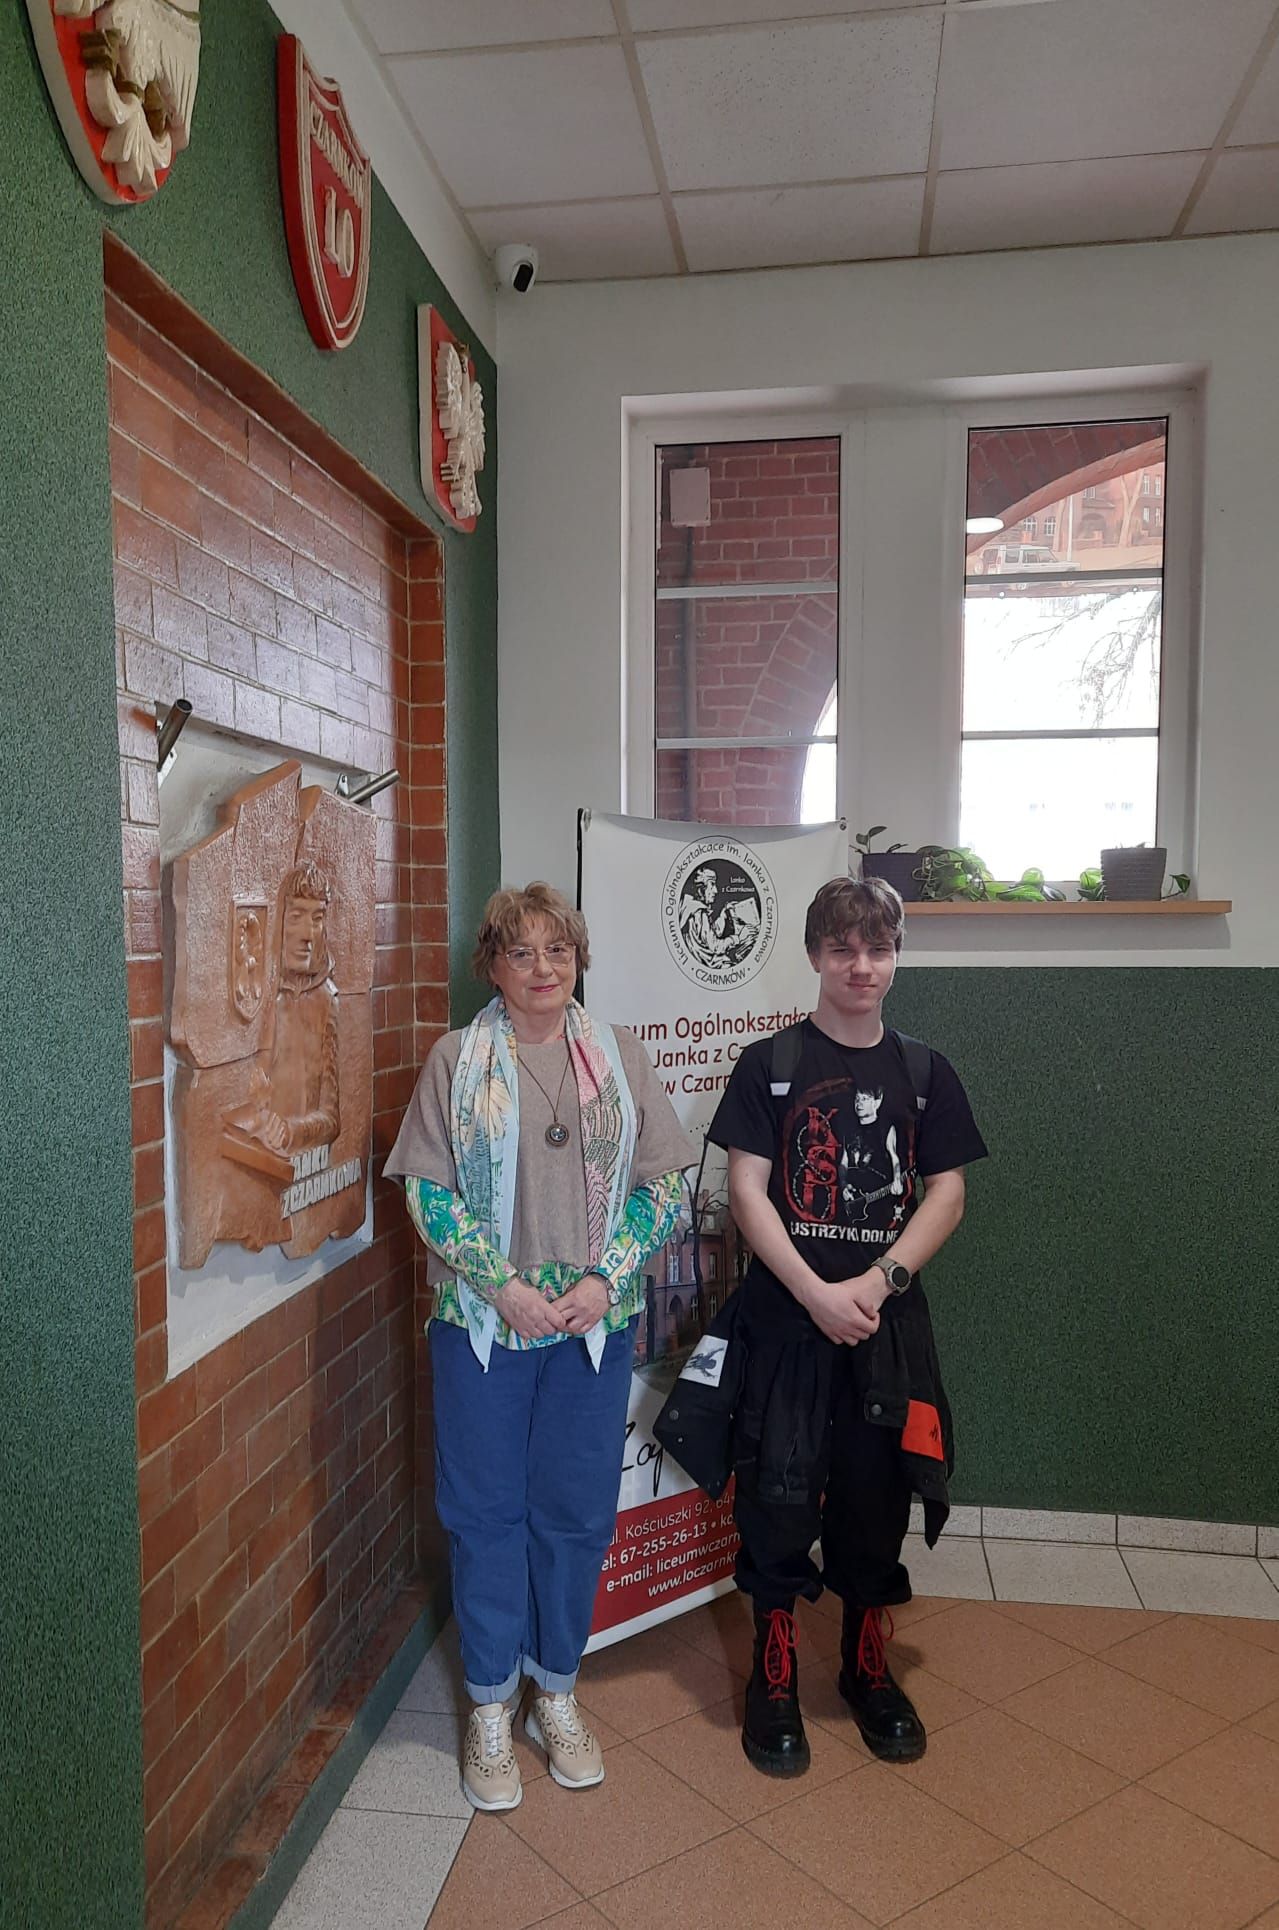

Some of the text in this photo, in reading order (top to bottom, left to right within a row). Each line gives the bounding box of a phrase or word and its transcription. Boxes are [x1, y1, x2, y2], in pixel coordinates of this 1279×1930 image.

[668, 920, 689, 966] Liceum
[754, 896, 774, 963] Czarnkowa
[695, 967, 746, 985] CZARNKÓW
[653, 1045, 708, 1069] Janka
[713, 1048, 723, 1063] z
[625, 1504, 692, 1540] Kościuszki
[620, 1521, 707, 1564] 67-255-26-13
[606, 1563, 653, 1592] e-mail:
